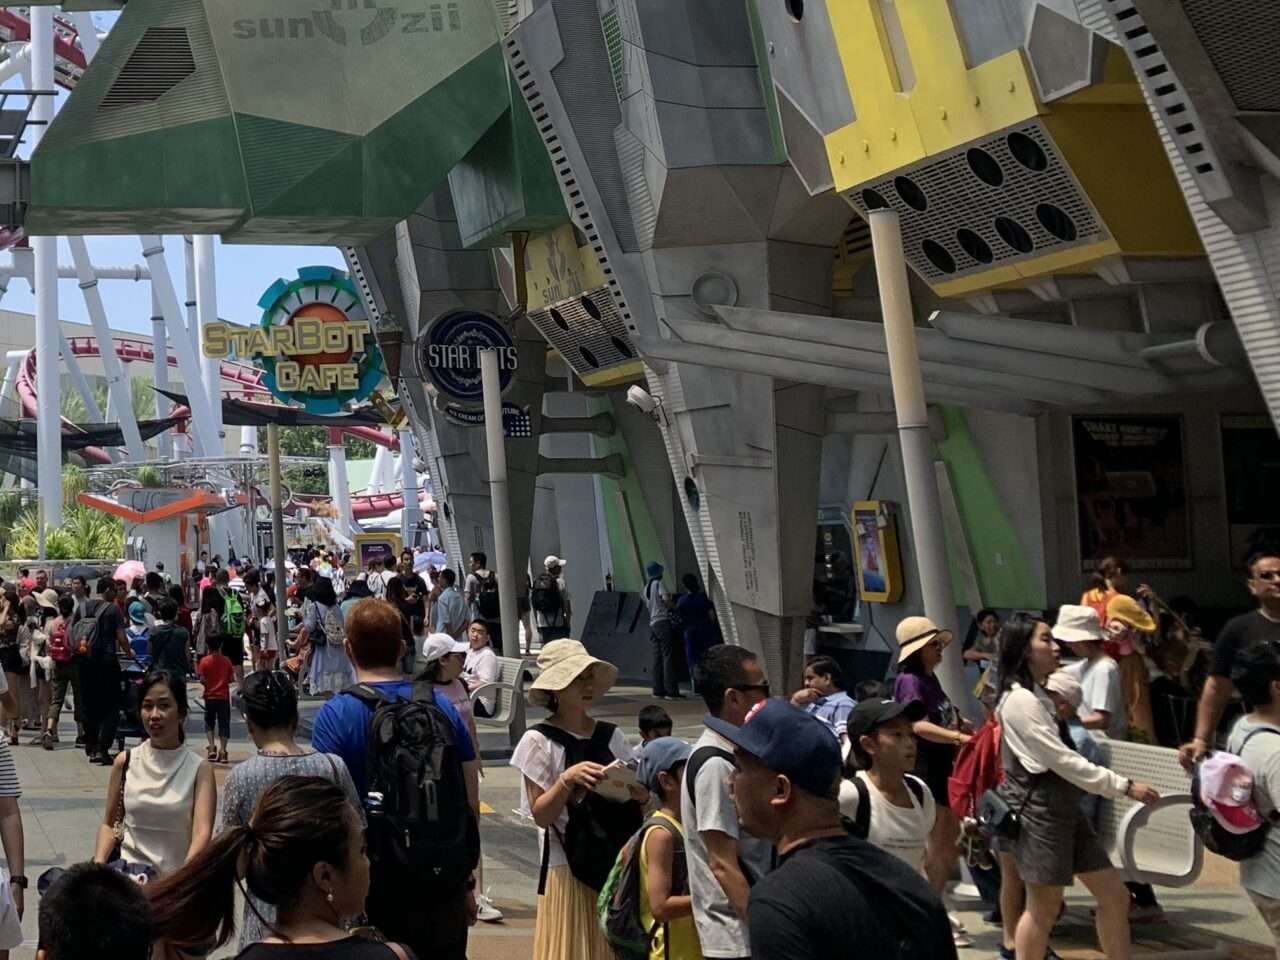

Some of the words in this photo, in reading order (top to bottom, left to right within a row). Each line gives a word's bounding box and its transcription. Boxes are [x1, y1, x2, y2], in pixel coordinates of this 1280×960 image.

[232, 17, 315, 40] sun
[400, 2, 462, 34] zii
[428, 344, 471, 369] STAR
[275, 361, 359, 392] CAFE
